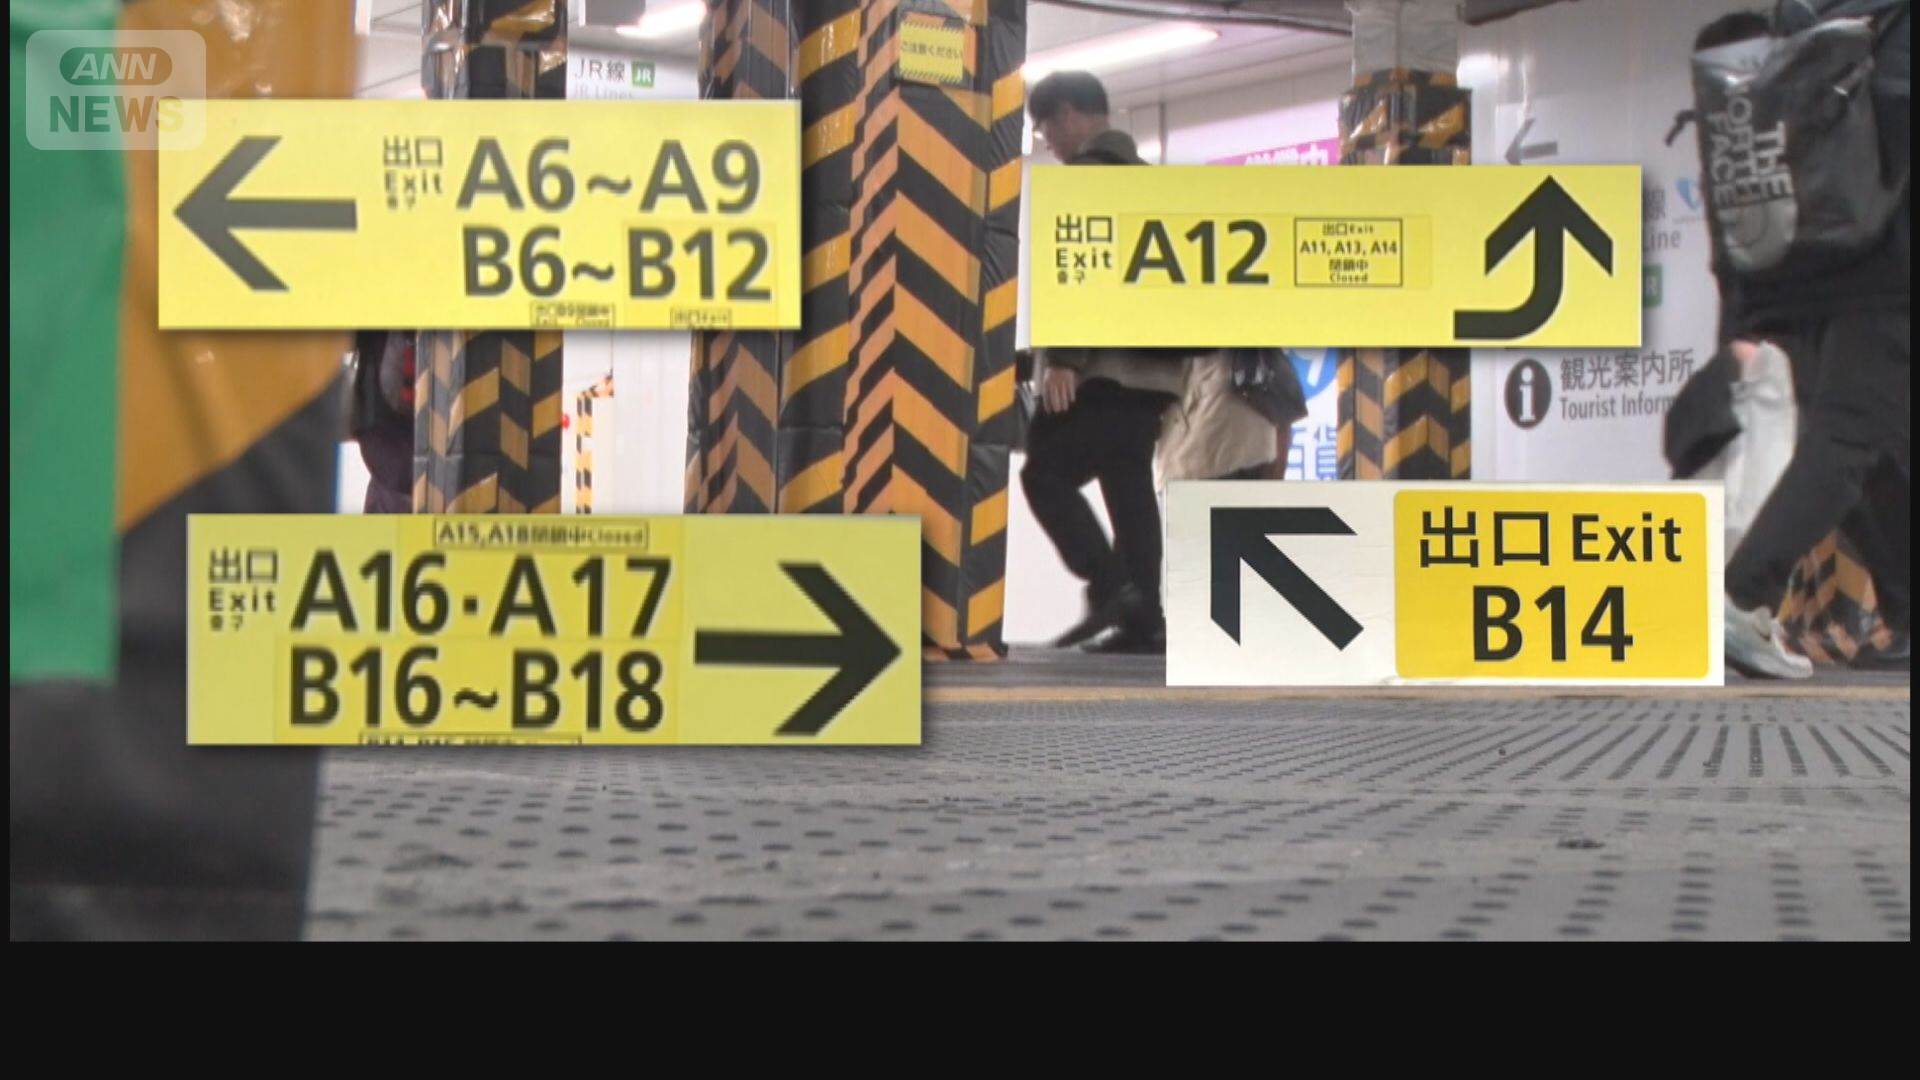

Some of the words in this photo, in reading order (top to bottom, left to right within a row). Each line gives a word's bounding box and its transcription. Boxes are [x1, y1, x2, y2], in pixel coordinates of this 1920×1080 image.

[383, 135, 443, 169] 出口
[1753, 120, 1795, 199] THE
[384, 170, 443, 195] Exit
[1056, 213, 1112, 244] 出口
[1056, 247, 1112, 269] Exit
[1123, 219, 1270, 285] A12
[1371, 240, 1398, 254] A14
[1560, 350, 1695, 391] 観光案内所
[1560, 395, 1616, 421] Tourist
[1419, 505, 1550, 569] 出口
[1572, 511, 1682, 562] Exit
[208, 547, 279, 584] 出口
[208, 587, 276, 613] Exit
[1472, 585, 1634, 662] B14
